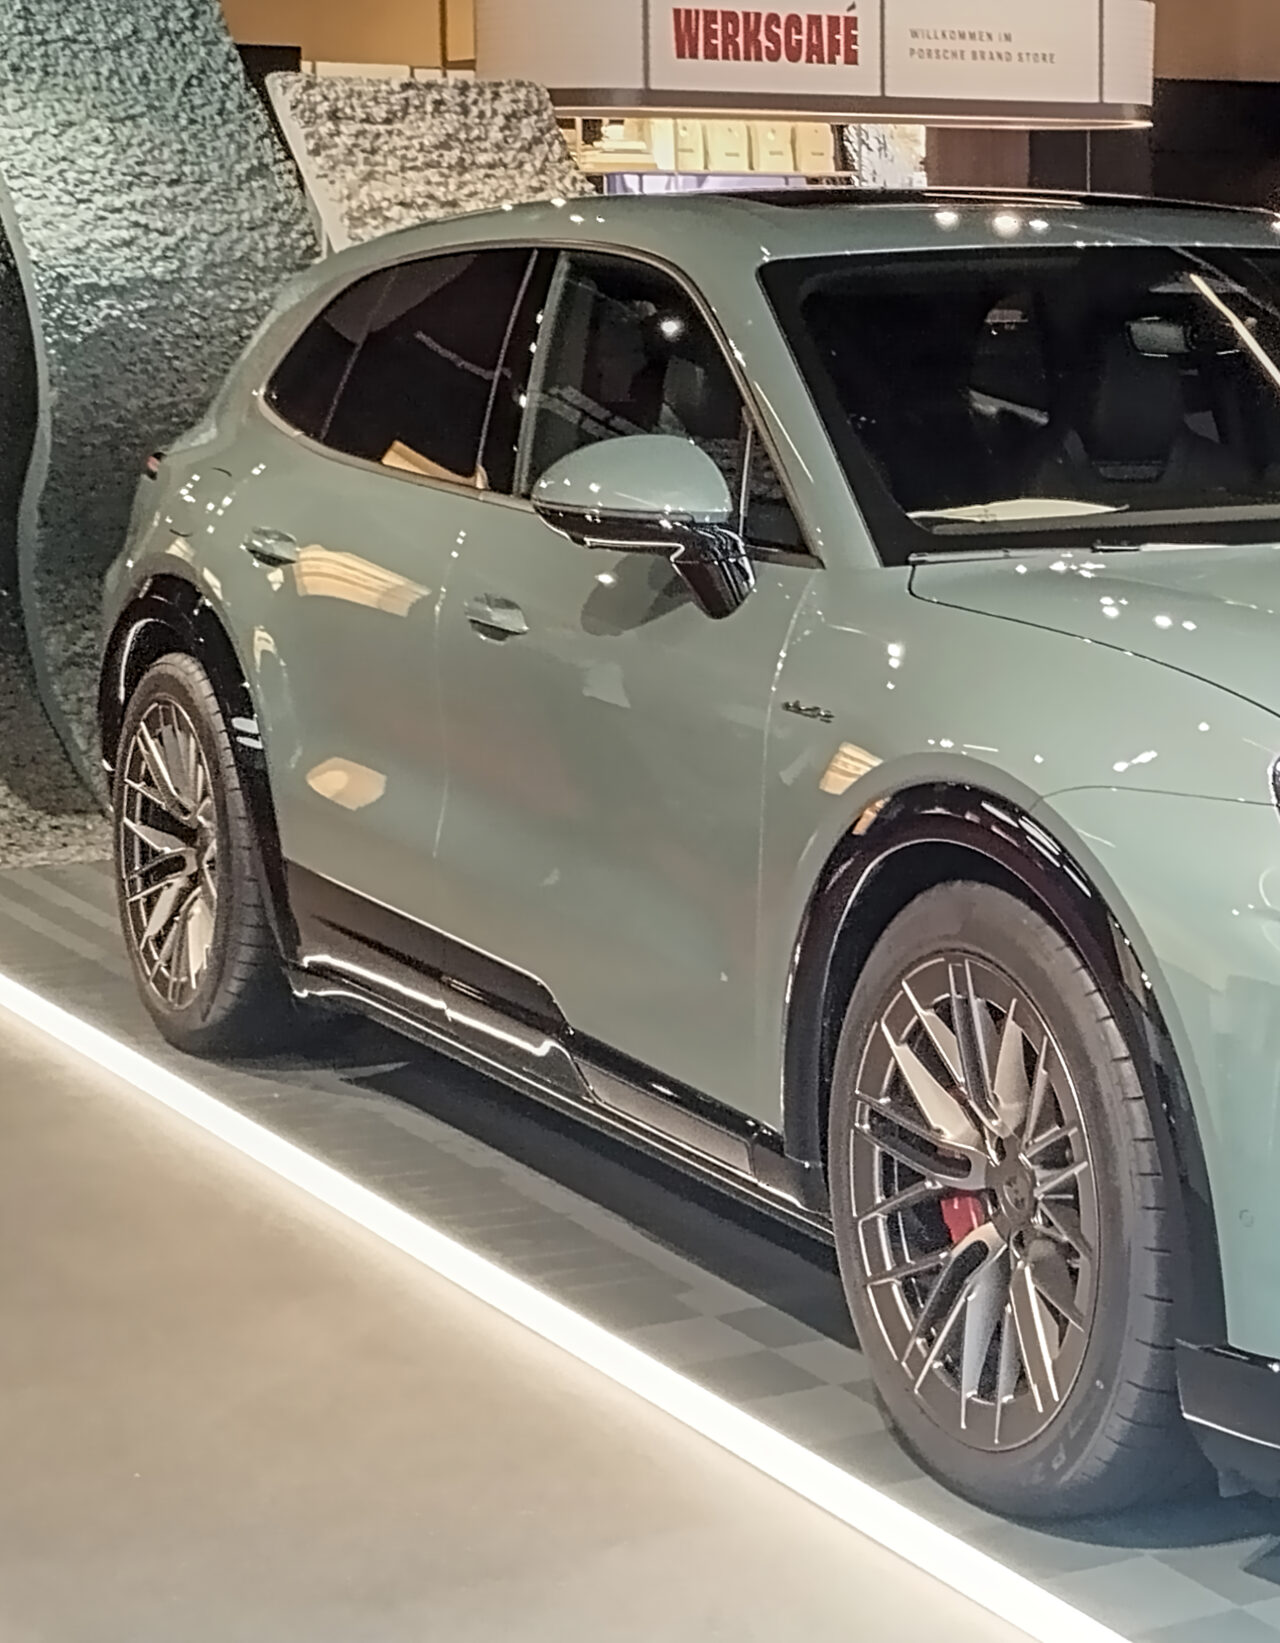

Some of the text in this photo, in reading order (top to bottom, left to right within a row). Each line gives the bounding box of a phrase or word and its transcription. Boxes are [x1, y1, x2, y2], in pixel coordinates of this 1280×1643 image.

[672, 1, 859, 66] WERKSCAFÉ
[908, 28, 1013, 43] WILLKOMMEN IN
[908, 47, 1056, 64] PORSCHE BRAND STORE
